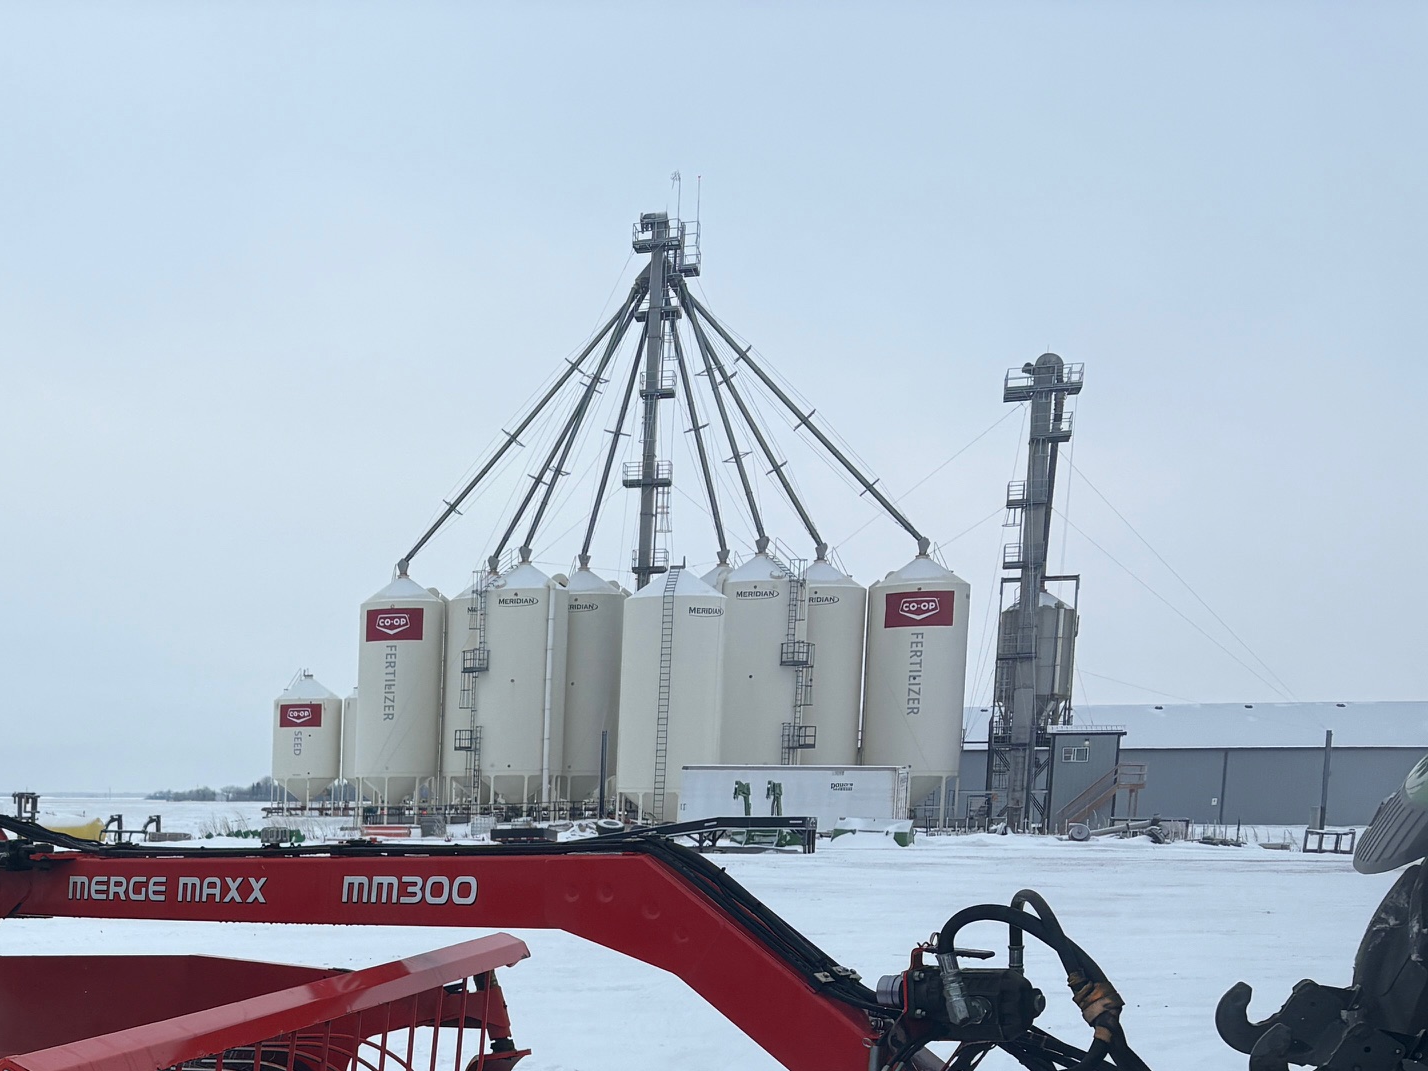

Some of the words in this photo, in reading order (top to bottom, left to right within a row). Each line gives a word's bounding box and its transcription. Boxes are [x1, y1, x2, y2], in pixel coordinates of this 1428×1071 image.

[498, 598, 535, 606] MERIDIAN
[736, 590, 774, 598] MERIDIAN
[688, 606, 722, 615] MERIDIAN
[902, 602, 936, 611] CO-OP
[378, 618, 407, 627] CO-OP
[906, 632, 924, 716] FERTILIZER
[383, 645, 397, 721] FERTILIZER
[293, 730, 303, 756] SEED
[68, 875, 167, 902] MERGE
[177, 876, 268, 904] MAXX
[341, 875, 478, 905] MM300
